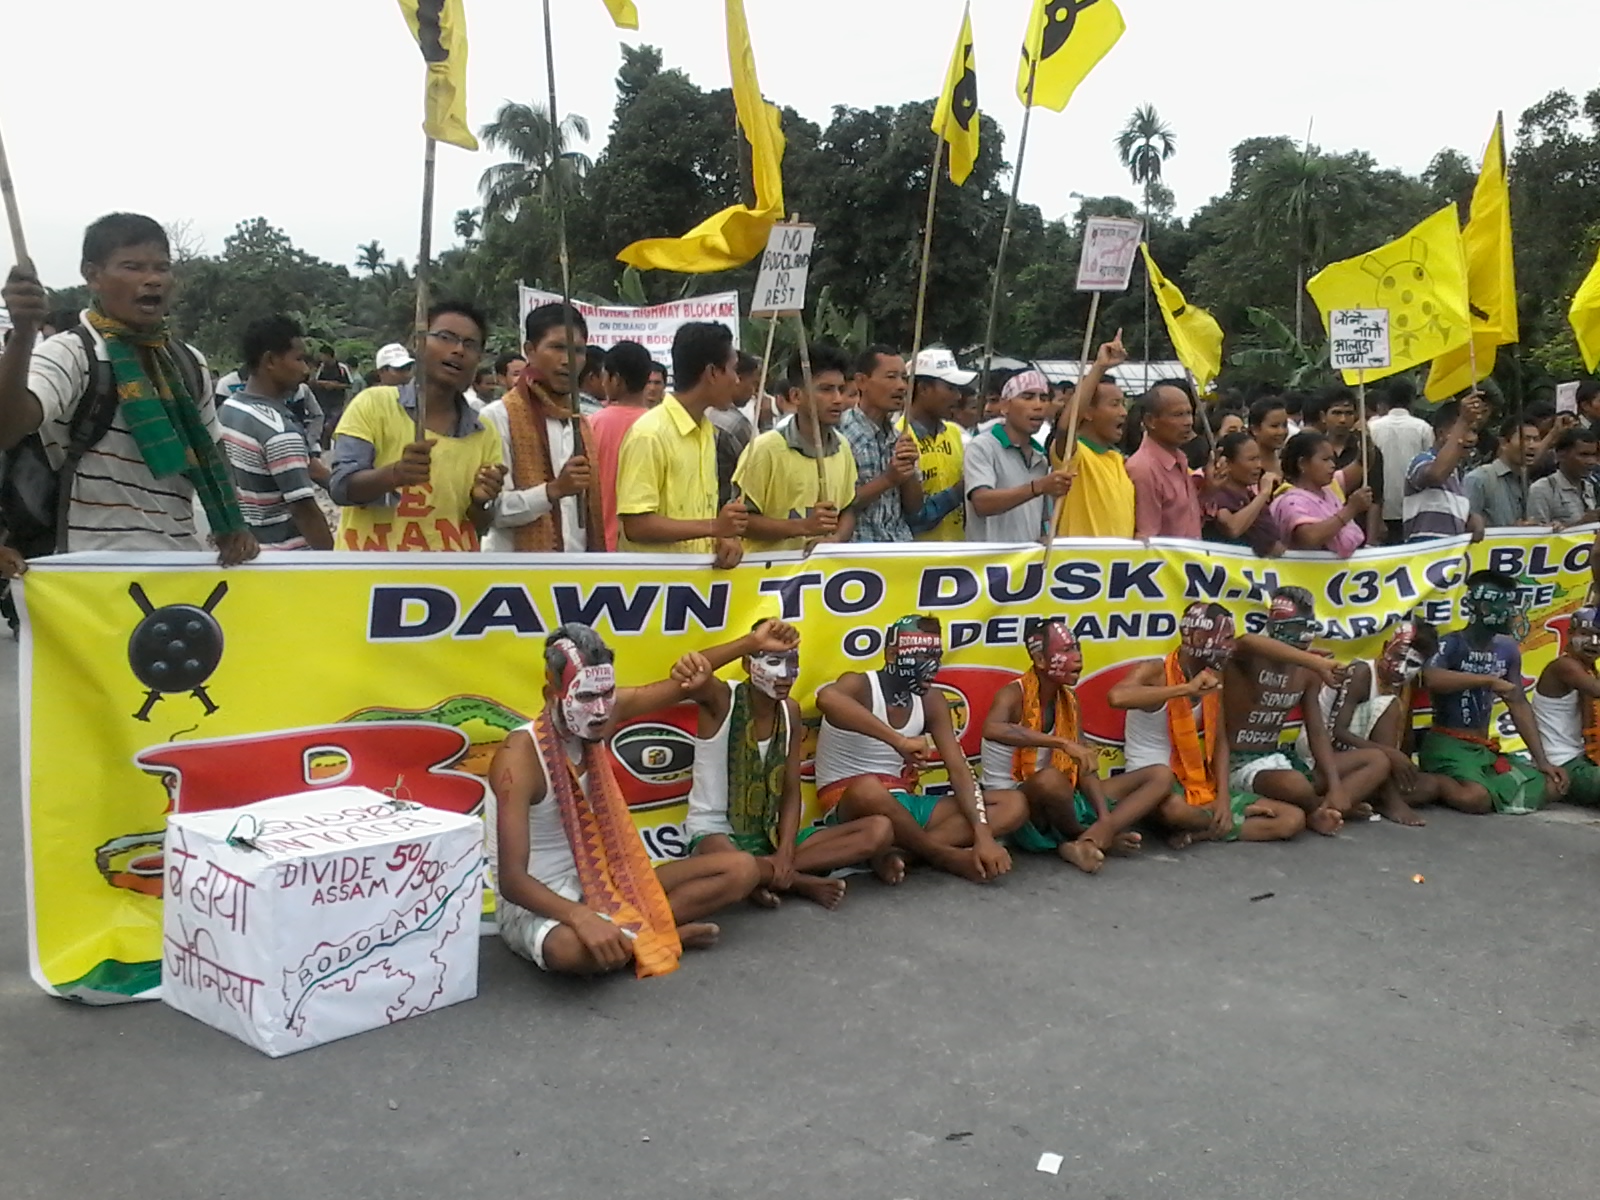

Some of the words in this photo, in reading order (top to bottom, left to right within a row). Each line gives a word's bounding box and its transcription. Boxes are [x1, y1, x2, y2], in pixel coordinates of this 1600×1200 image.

[781, 229, 802, 251] NO
[775, 271, 790, 288] NO
[764, 286, 795, 307] REST
[683, 302, 735, 318] BLOCKADE
[370, 583, 732, 639] DAWN
[758, 569, 885, 620] TO
[916, 560, 1165, 609] DUSK
[280, 856, 376, 889] DIVIDE
[386, 841, 440, 898] 50/50
[311, 877, 389, 907] ASSAM
[298, 885, 449, 988] BODOLAND
